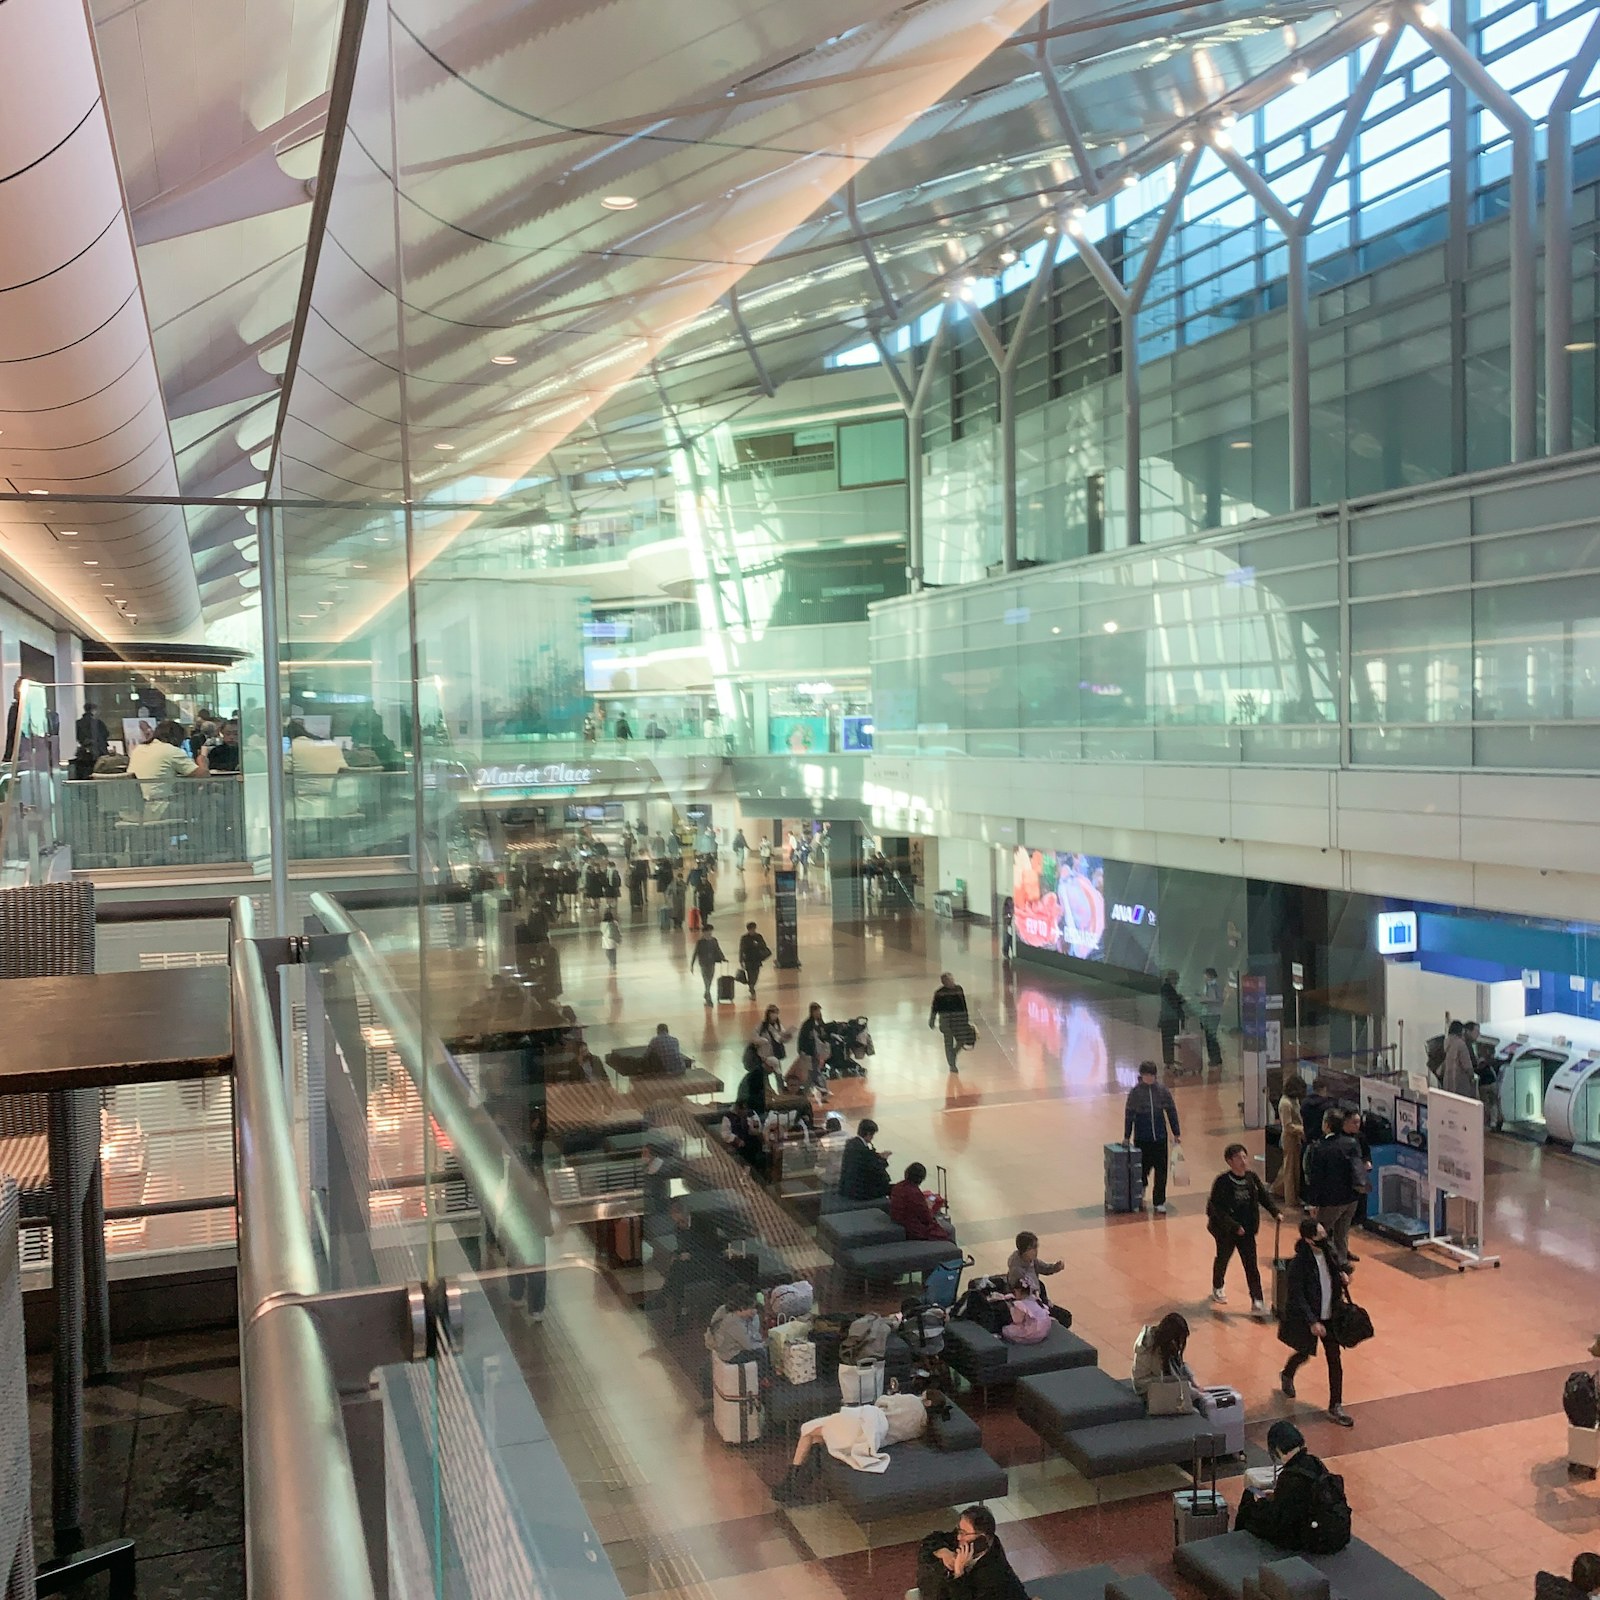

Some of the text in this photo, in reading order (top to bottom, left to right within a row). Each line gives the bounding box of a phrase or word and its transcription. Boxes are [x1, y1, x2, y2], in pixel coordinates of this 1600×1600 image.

[477, 763, 591, 784] Market Place
[1111, 904, 1133, 921] ANA
